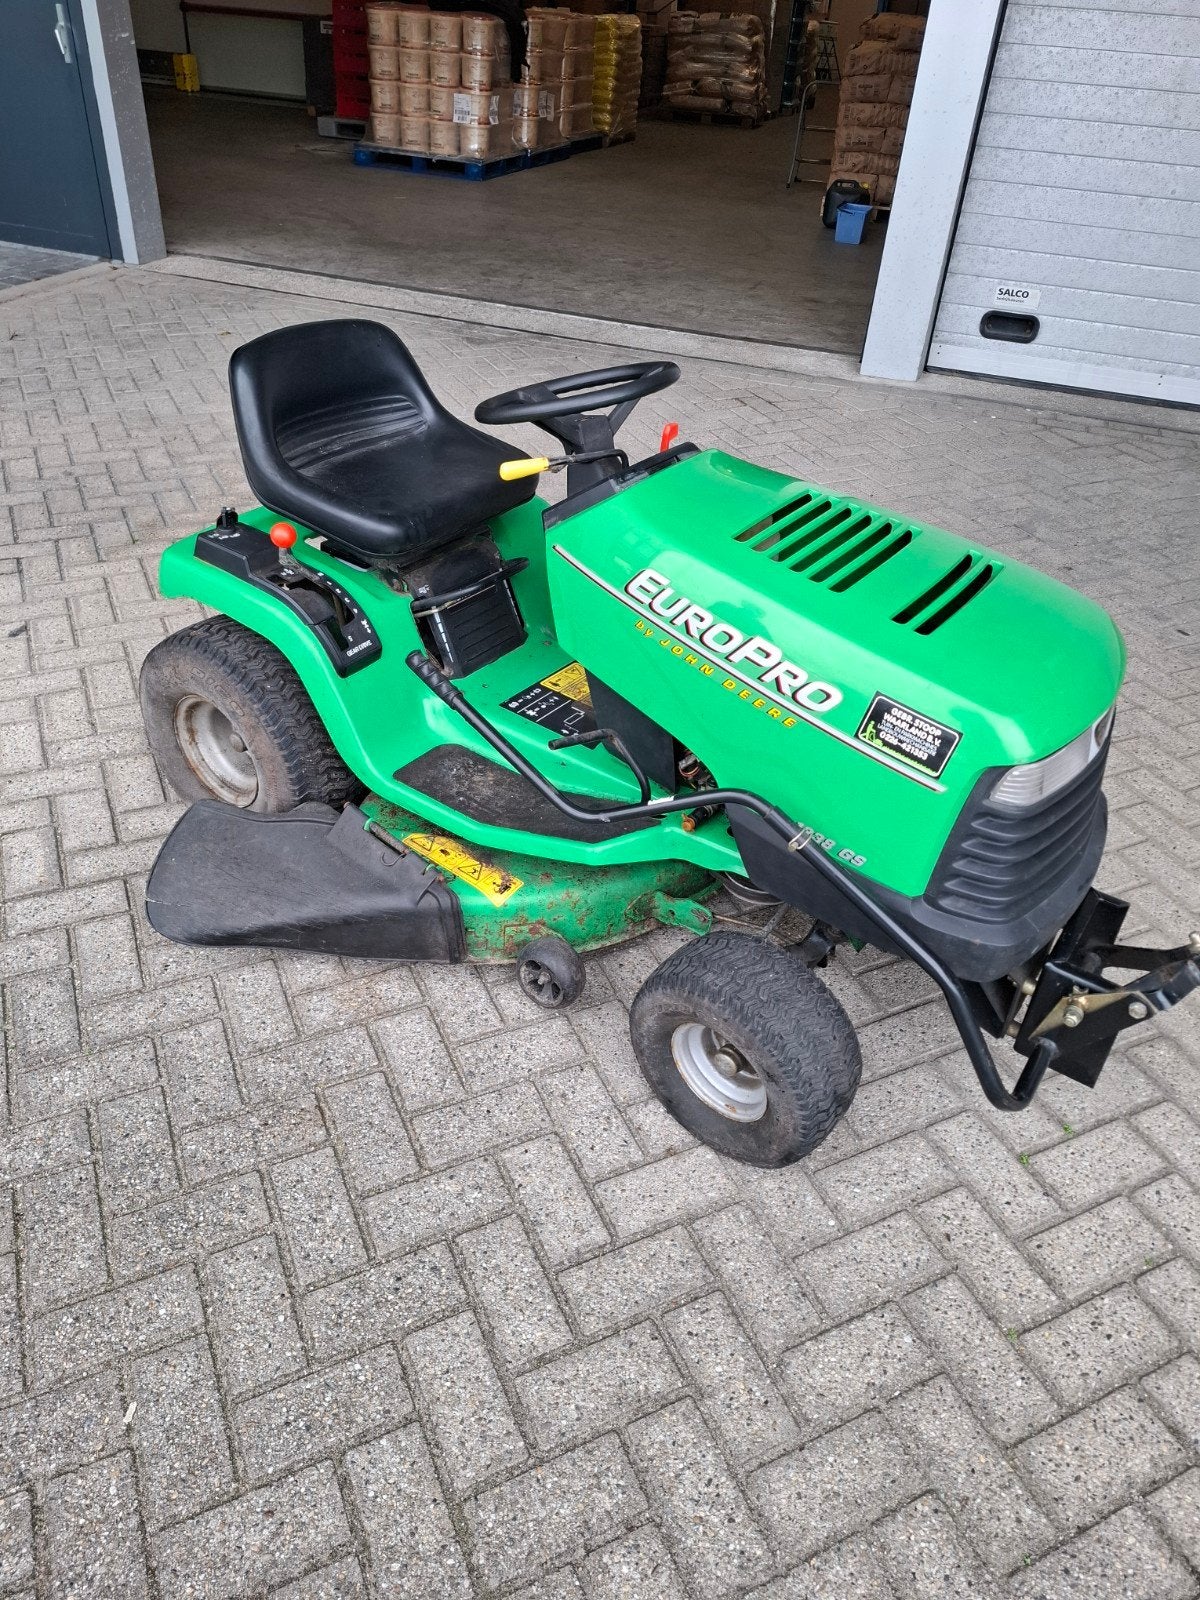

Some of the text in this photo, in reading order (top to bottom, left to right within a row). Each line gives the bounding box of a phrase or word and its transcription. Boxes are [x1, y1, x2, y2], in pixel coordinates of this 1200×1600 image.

[998, 288, 1029, 298] SALCO
[635, 620, 797, 727] by JOHN DEERE
[883, 712, 928, 741] WAARLAND
[891, 707, 941, 736] GEBR. STOOP
[838, 848, 868, 867] GS
